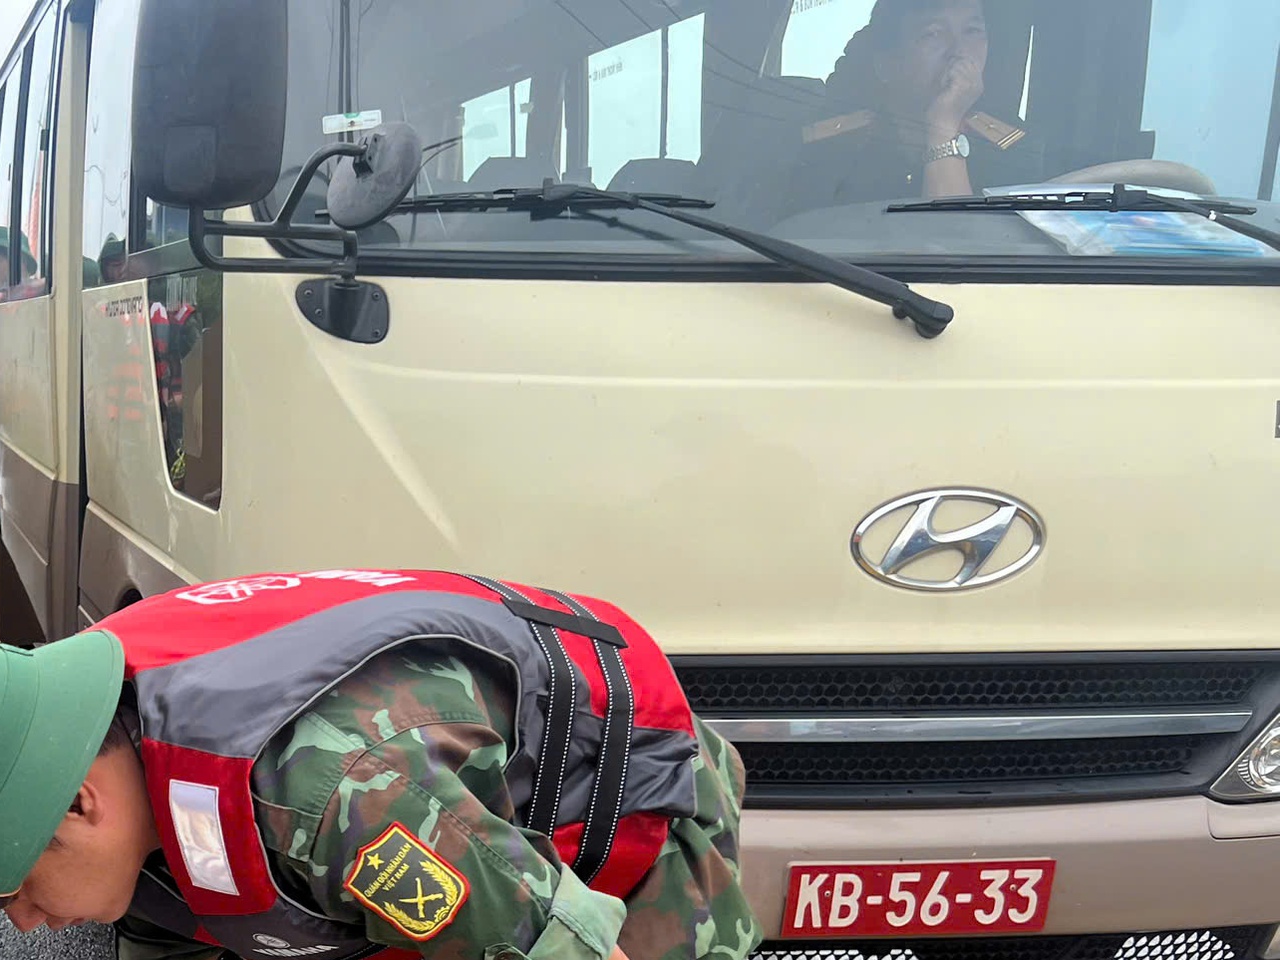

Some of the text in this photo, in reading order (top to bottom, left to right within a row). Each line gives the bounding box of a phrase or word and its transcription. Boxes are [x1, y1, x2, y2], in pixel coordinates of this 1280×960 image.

[363, 882, 381, 898] QUÂN
[385, 856, 403, 874] NHÂN
[397, 842, 412, 857] DÂN
[382, 862, 410, 891] VIỆT NAM
[793, 868, 1044, 928] KB-56-33
